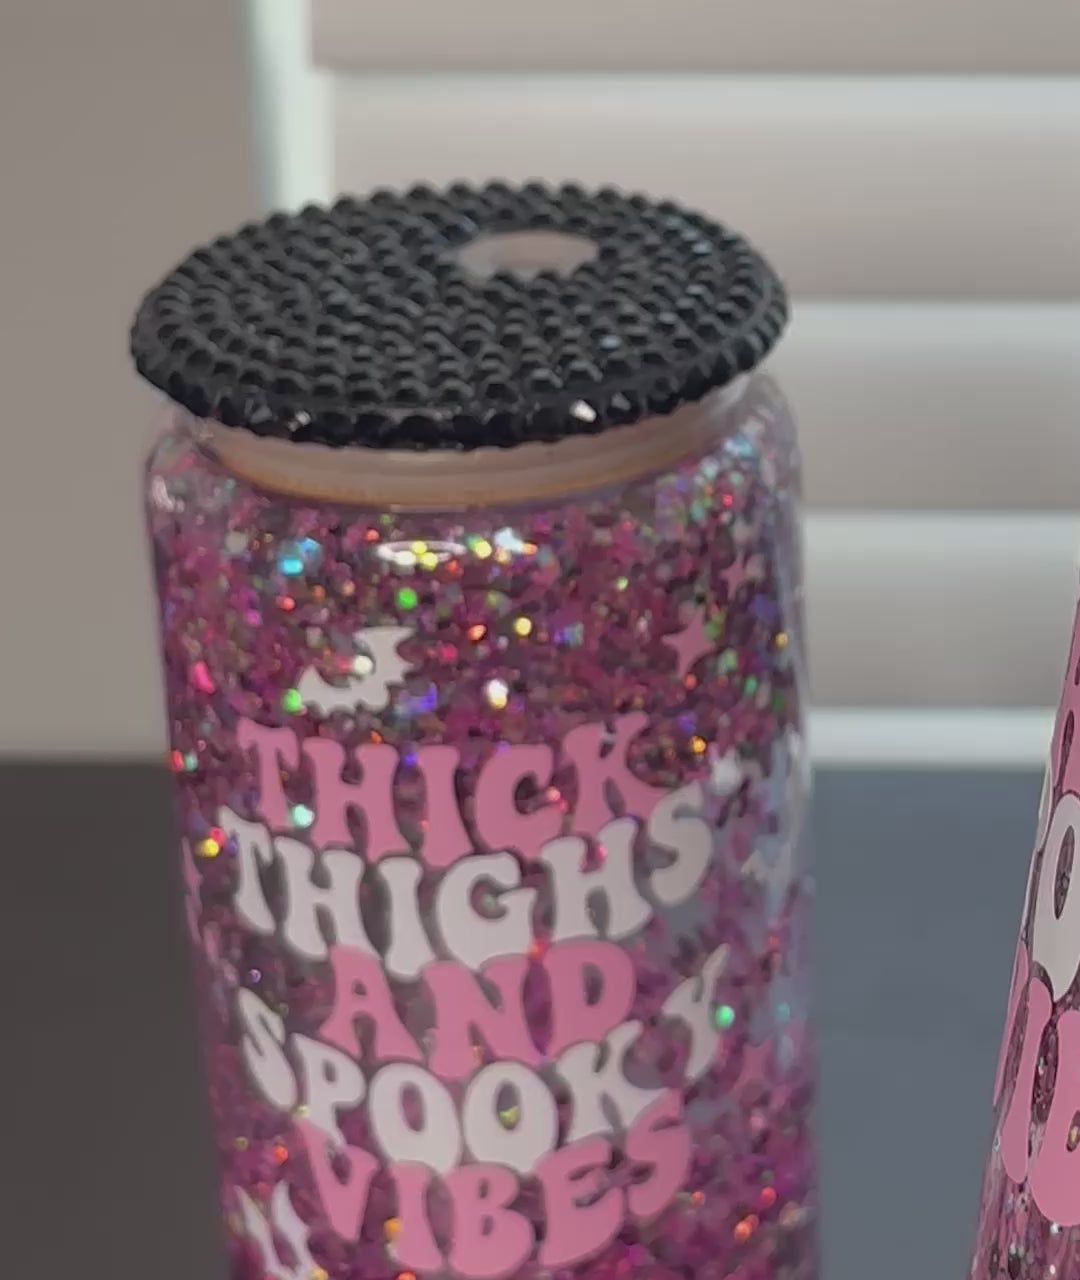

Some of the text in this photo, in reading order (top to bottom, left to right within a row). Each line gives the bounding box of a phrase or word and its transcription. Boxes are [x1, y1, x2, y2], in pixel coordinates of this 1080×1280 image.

[219, 780, 712, 976] THIGHS
[238, 712, 670, 868] THICK
[238, 943, 730, 1175] SPOOKY
[319, 938, 636, 1079] AND
[296, 1089, 692, 1278] VIBES
